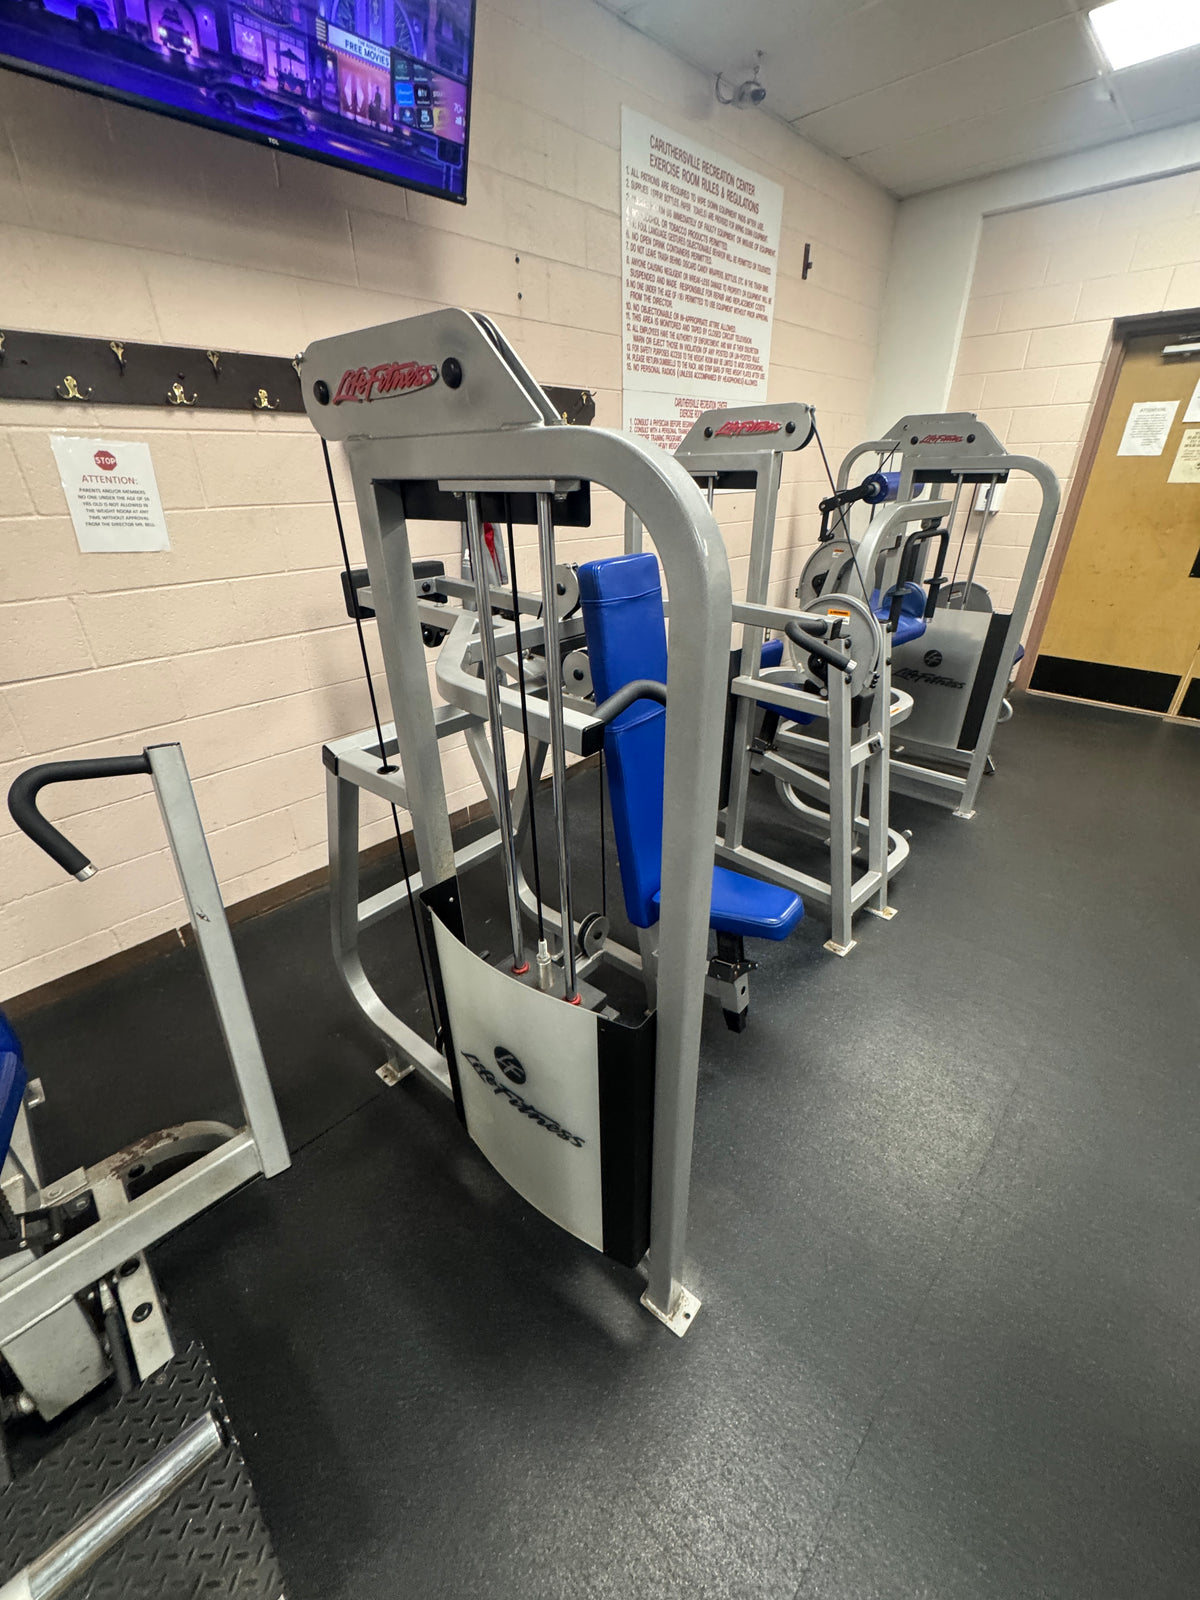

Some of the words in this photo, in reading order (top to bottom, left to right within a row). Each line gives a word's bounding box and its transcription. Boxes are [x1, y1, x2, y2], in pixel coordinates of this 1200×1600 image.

[345, 40, 363, 54] FREE
[364, 48, 390, 66] MOVIES
[650, 134, 700, 171] CARUTHERSVILLE
[702, 160, 735, 187] RECREATION
[736, 177, 755, 197] CENTER
[650, 153, 680, 179] EXERCISE
[682, 168, 699, 188] ROOM
[702, 178, 719, 197] RULES
[727, 189, 759, 214] REGULATIONS
[669, 222, 687, 236] TOBACCO
[630, 268, 655, 283] SUSPENDED
[630, 291, 642, 301] FROM
[641, 365, 660, 374] PERSONAL
[662, 368, 675, 376] RADIOS
[82, 475, 139, 485] ATTENTION:
